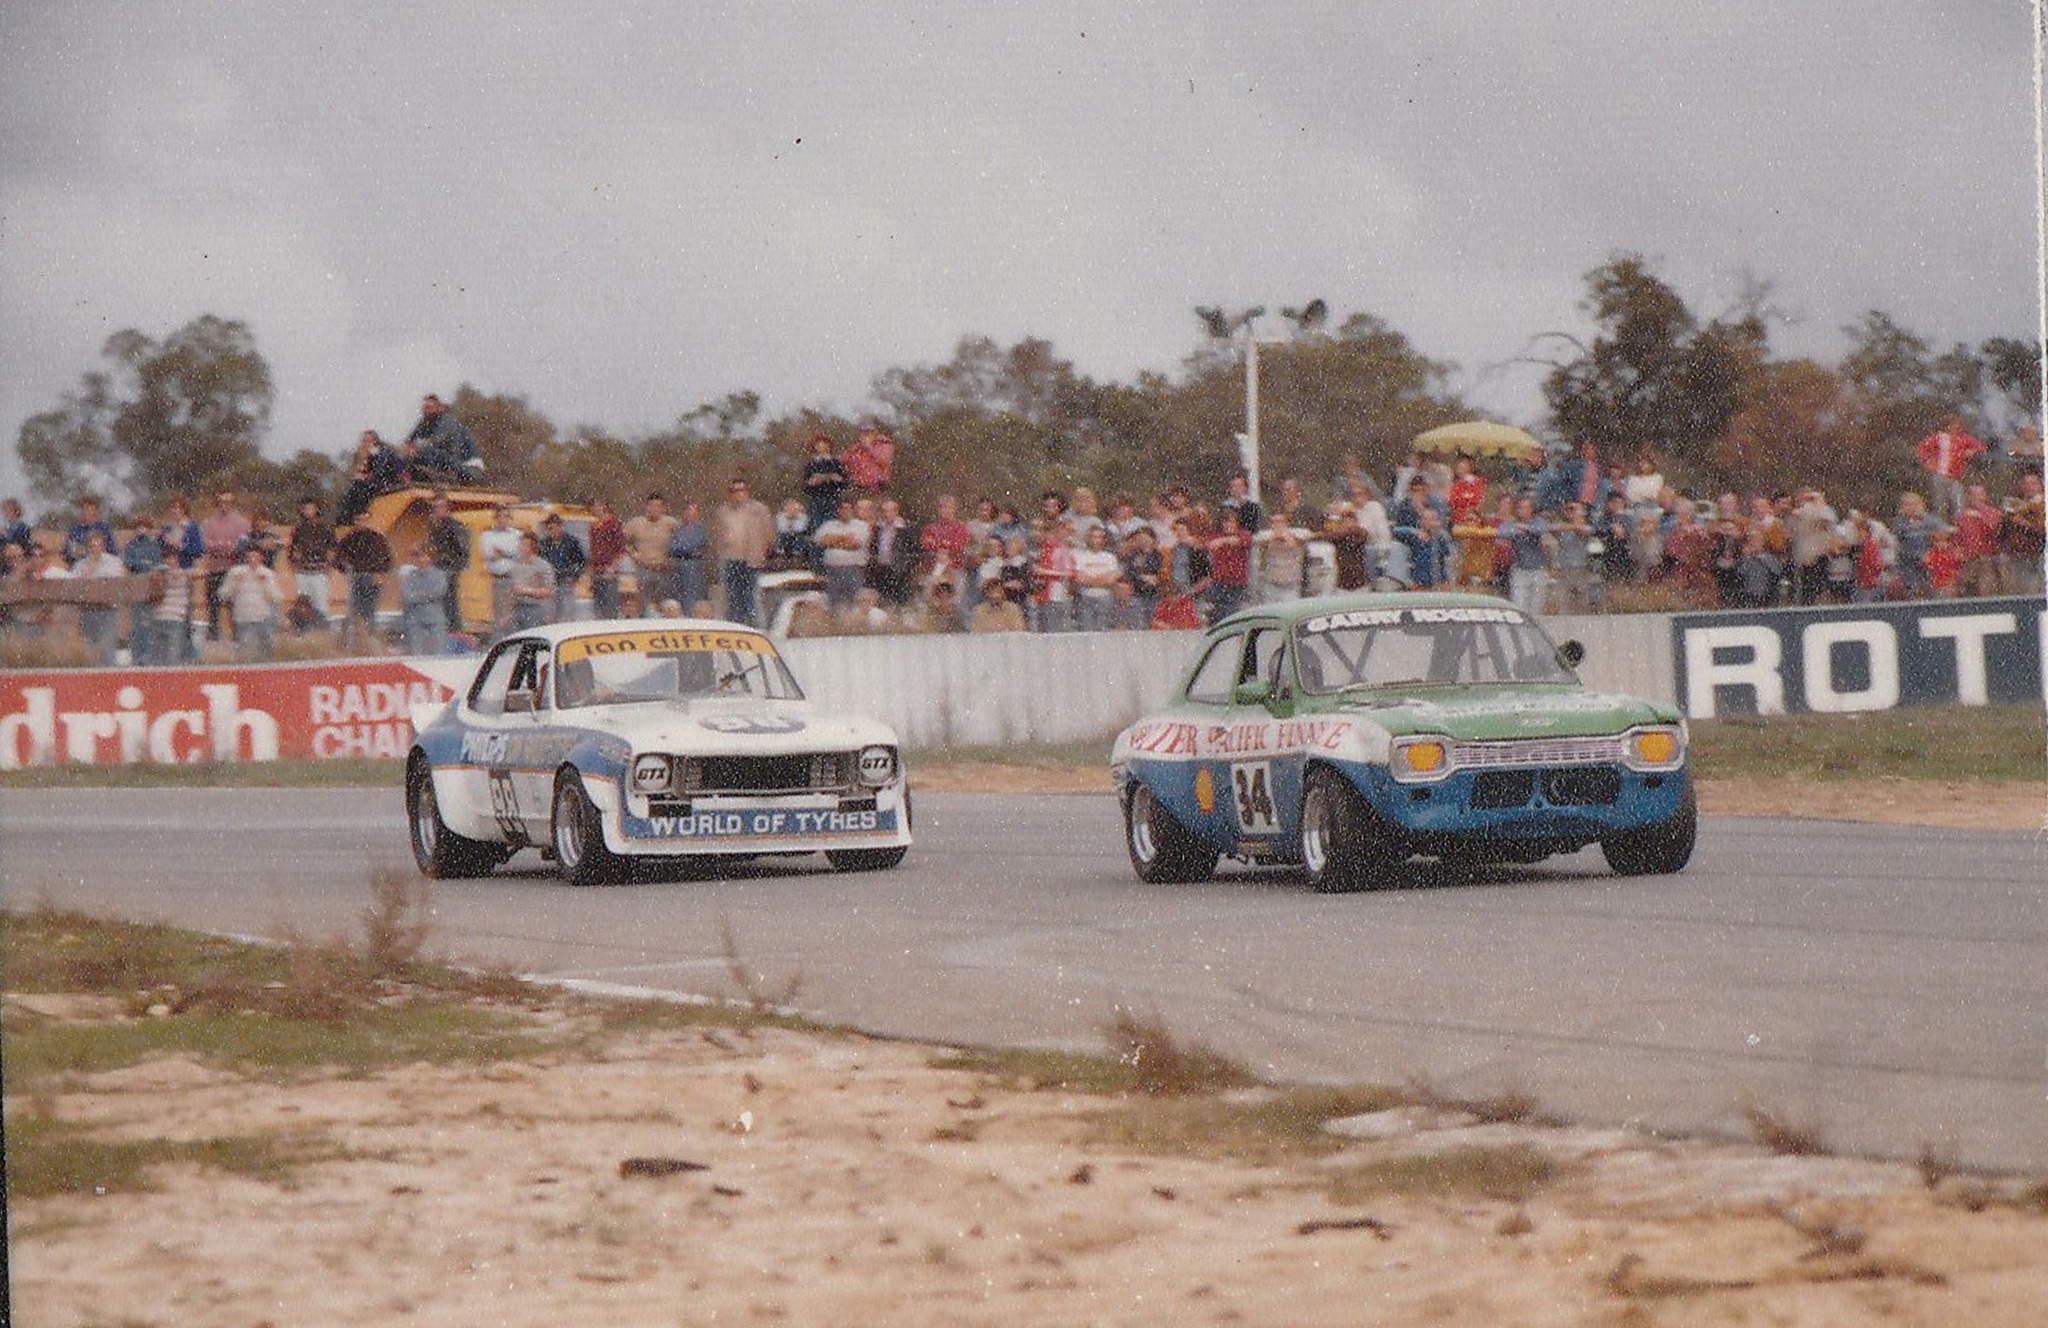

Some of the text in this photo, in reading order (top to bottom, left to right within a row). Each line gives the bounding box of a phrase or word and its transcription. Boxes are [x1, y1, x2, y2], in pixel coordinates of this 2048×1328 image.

[584, 639, 637, 655] ian
[1684, 611, 2047, 719] ROT
[637, 767, 665, 780] GTX
[861, 757, 889, 770] GTX
[1235, 768, 1274, 826] 34
[650, 811, 877, 836] WORLD OF TYRES
